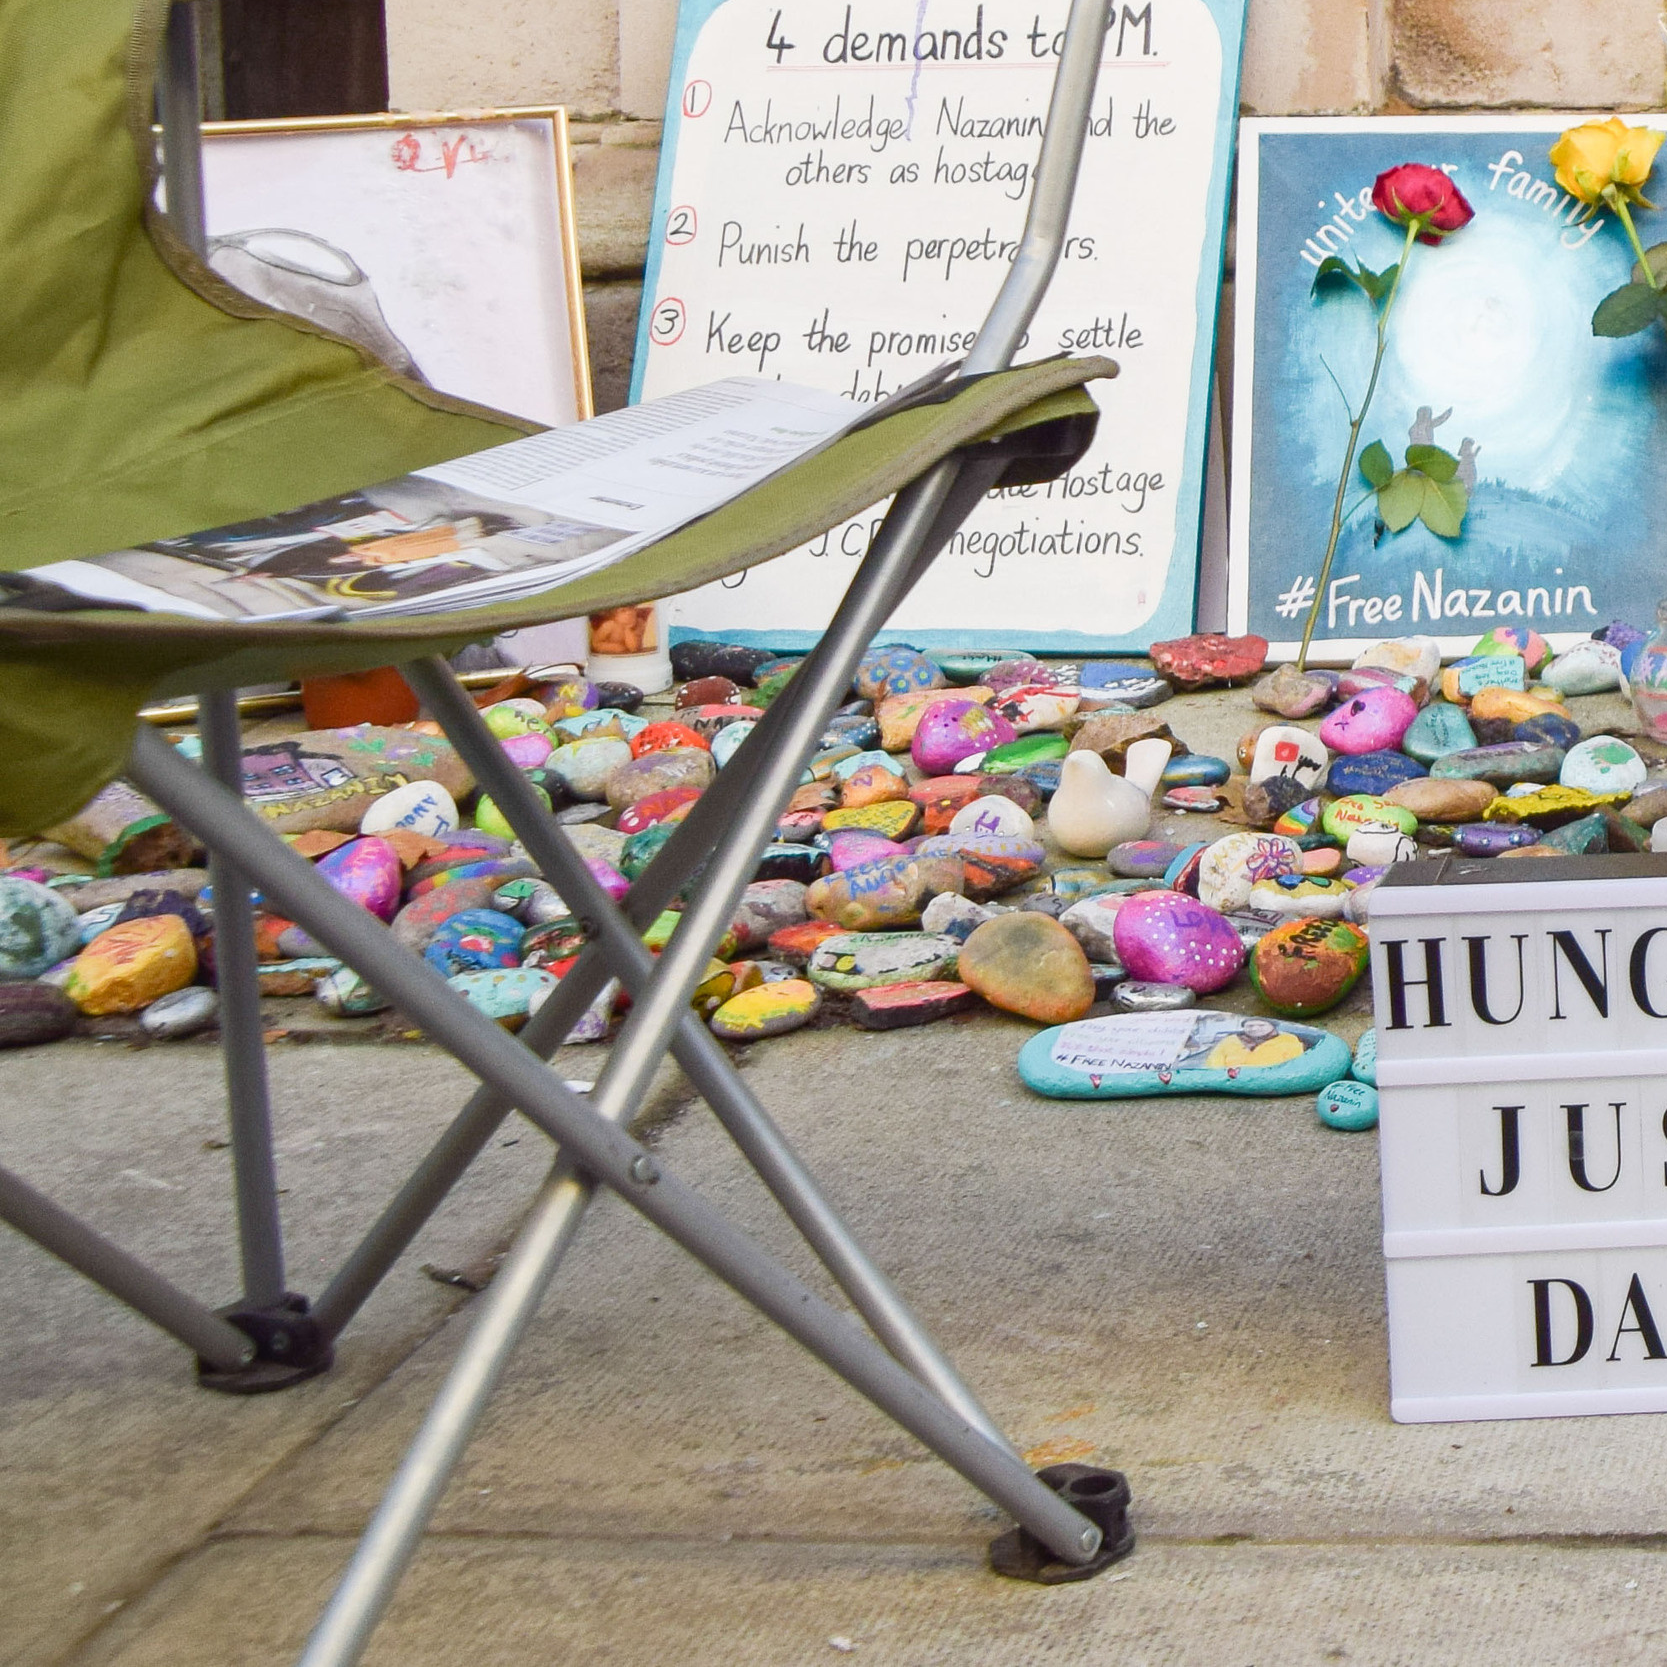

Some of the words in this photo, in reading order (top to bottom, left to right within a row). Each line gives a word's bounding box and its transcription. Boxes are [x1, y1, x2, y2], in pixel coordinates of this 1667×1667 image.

[766, 10, 794, 63] 4
[823, 4, 1008, 64] demands
[723, 95, 906, 152] Acknowledge
[936, 97, 1044, 139] Nazanin
[1132, 100, 1177, 138] the
[785, 149, 871, 187] others
[889, 163, 919, 185] as
[933, 145, 1039, 200] hostag
[669, 212, 693, 237] 2
[719, 220, 811, 268] Punish
[833, 218, 879, 262] the
[653, 308, 680, 336] 3
[705, 309, 782, 372] Keep
[803, 306, 852, 355] the
[1058, 311, 1145, 351] settle
[949, 522, 1145, 578] negotiations.
